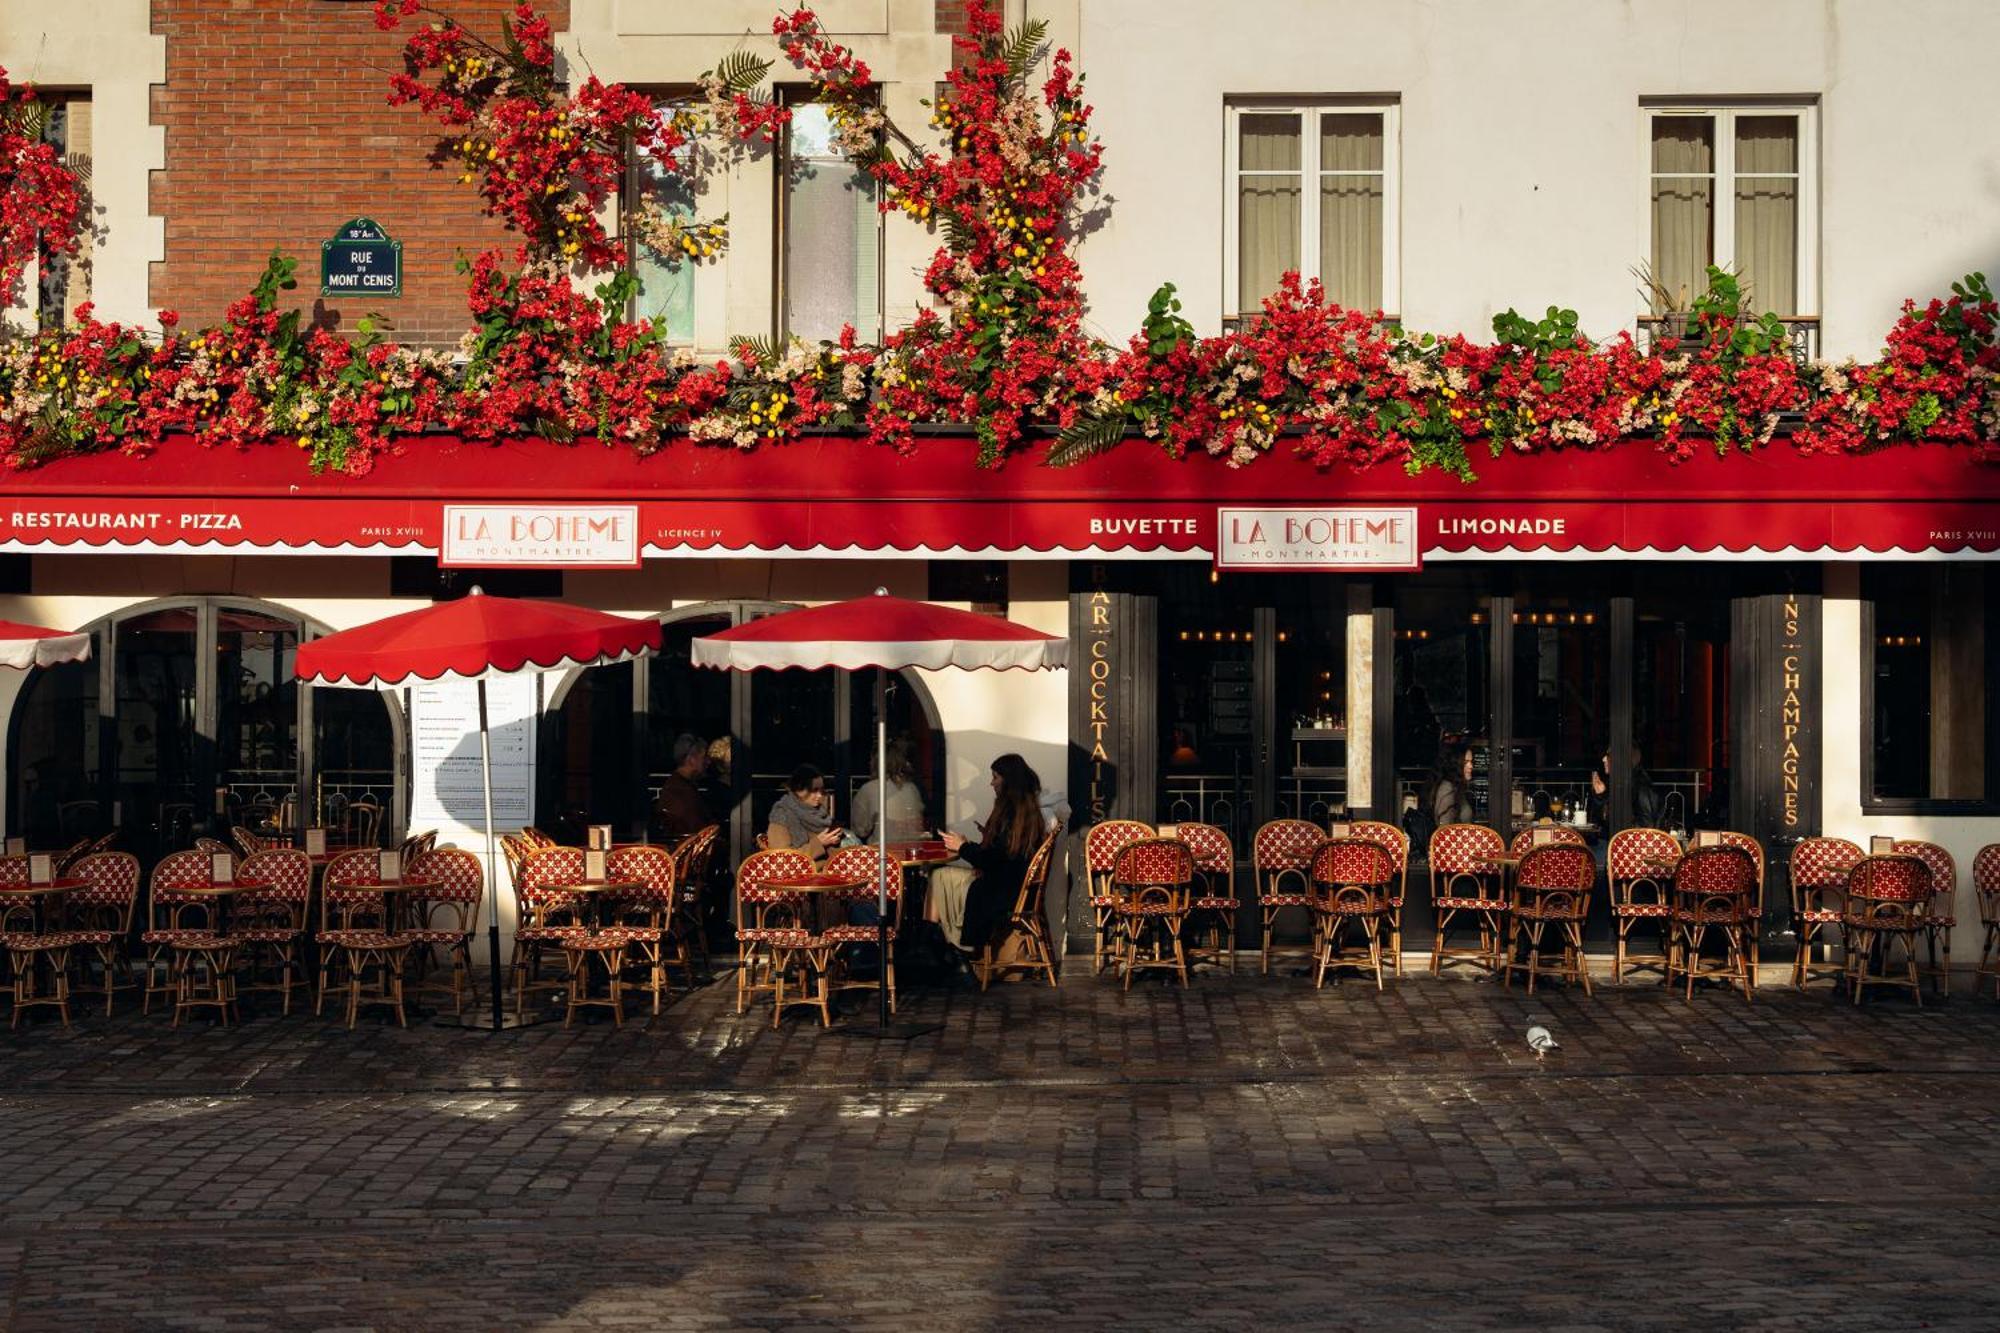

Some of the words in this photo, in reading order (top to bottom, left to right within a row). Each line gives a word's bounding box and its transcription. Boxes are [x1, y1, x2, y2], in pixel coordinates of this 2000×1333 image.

[351, 251, 373, 263] RUE
[329, 274, 359, 286] MONT
[363, 274, 394, 286] CENIS
[11, 513, 161, 528] RESTAURANT
[180, 514, 242, 529] PIZZA
[459, 515, 491, 541] LA
[511, 515, 626, 542] BOHEME
[1090, 518, 1197, 535] BUVETTE
[1438, 518, 1565, 535] LIMONADE
[361, 527, 392, 536] PARIS
[396, 527, 424, 536] XVIII
[658, 529, 705, 538] LICENCE
[711, 529, 722, 538] IV
[1232, 518, 1266, 544] LA
[1286, 518, 1404, 545] BOHEME
[1929, 531, 1961, 540] PARIS
[1967, 531, 1996, 540] XVIII
[1251, 550, 1370, 559] MONTMARTRE
[1090, 640, 1110, 819] COCKTAILS
[1783, 656, 1801, 826] CHAMPAGNES
